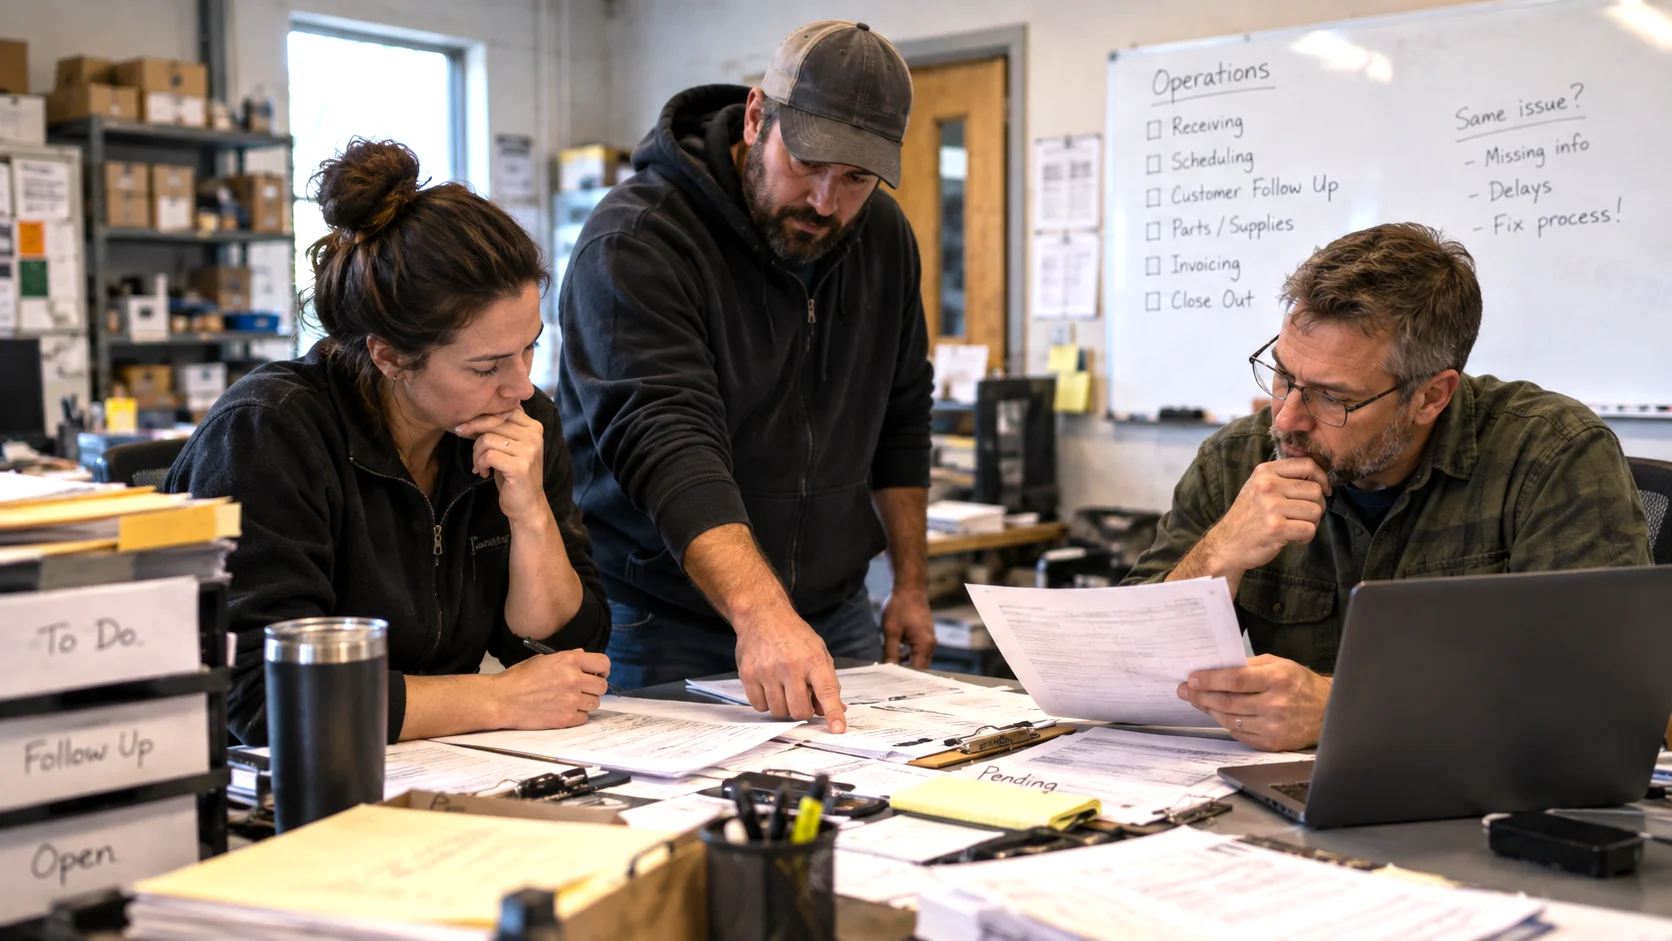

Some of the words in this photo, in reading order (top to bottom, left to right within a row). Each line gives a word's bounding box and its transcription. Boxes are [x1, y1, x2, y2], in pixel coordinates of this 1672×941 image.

[1152, 62, 1270, 104] Operations
[1455, 106, 1506, 130] Same
[1518, 82, 1584, 118] issue?
[1172, 116, 1243, 139] Receiving
[1171, 147, 1254, 174] Scheduling
[1485, 146, 1545, 168] Missing
[1555, 132, 1590, 154] info
[1171, 184, 1242, 205] Customer
[1253, 177, 1302, 198] Follow
[1313, 174, 1339, 202] Up
[1489, 178, 1552, 204] Delays
[1172, 218, 1211, 238] Parts
[1229, 214, 1294, 240] Supplies
[1494, 213, 1524, 235] Fix
[1537, 196, 1622, 238] process!
[1170, 254, 1241, 282] Invoicing
[1171, 290, 1212, 310] Close
[1222, 289, 1255, 308] Out
[36, 621, 78, 656] To
[24, 737, 108, 775] Follow
[118, 729, 154, 768] Up
[977, 765, 1058, 795] Pending
[30, 842, 116, 886] Open
